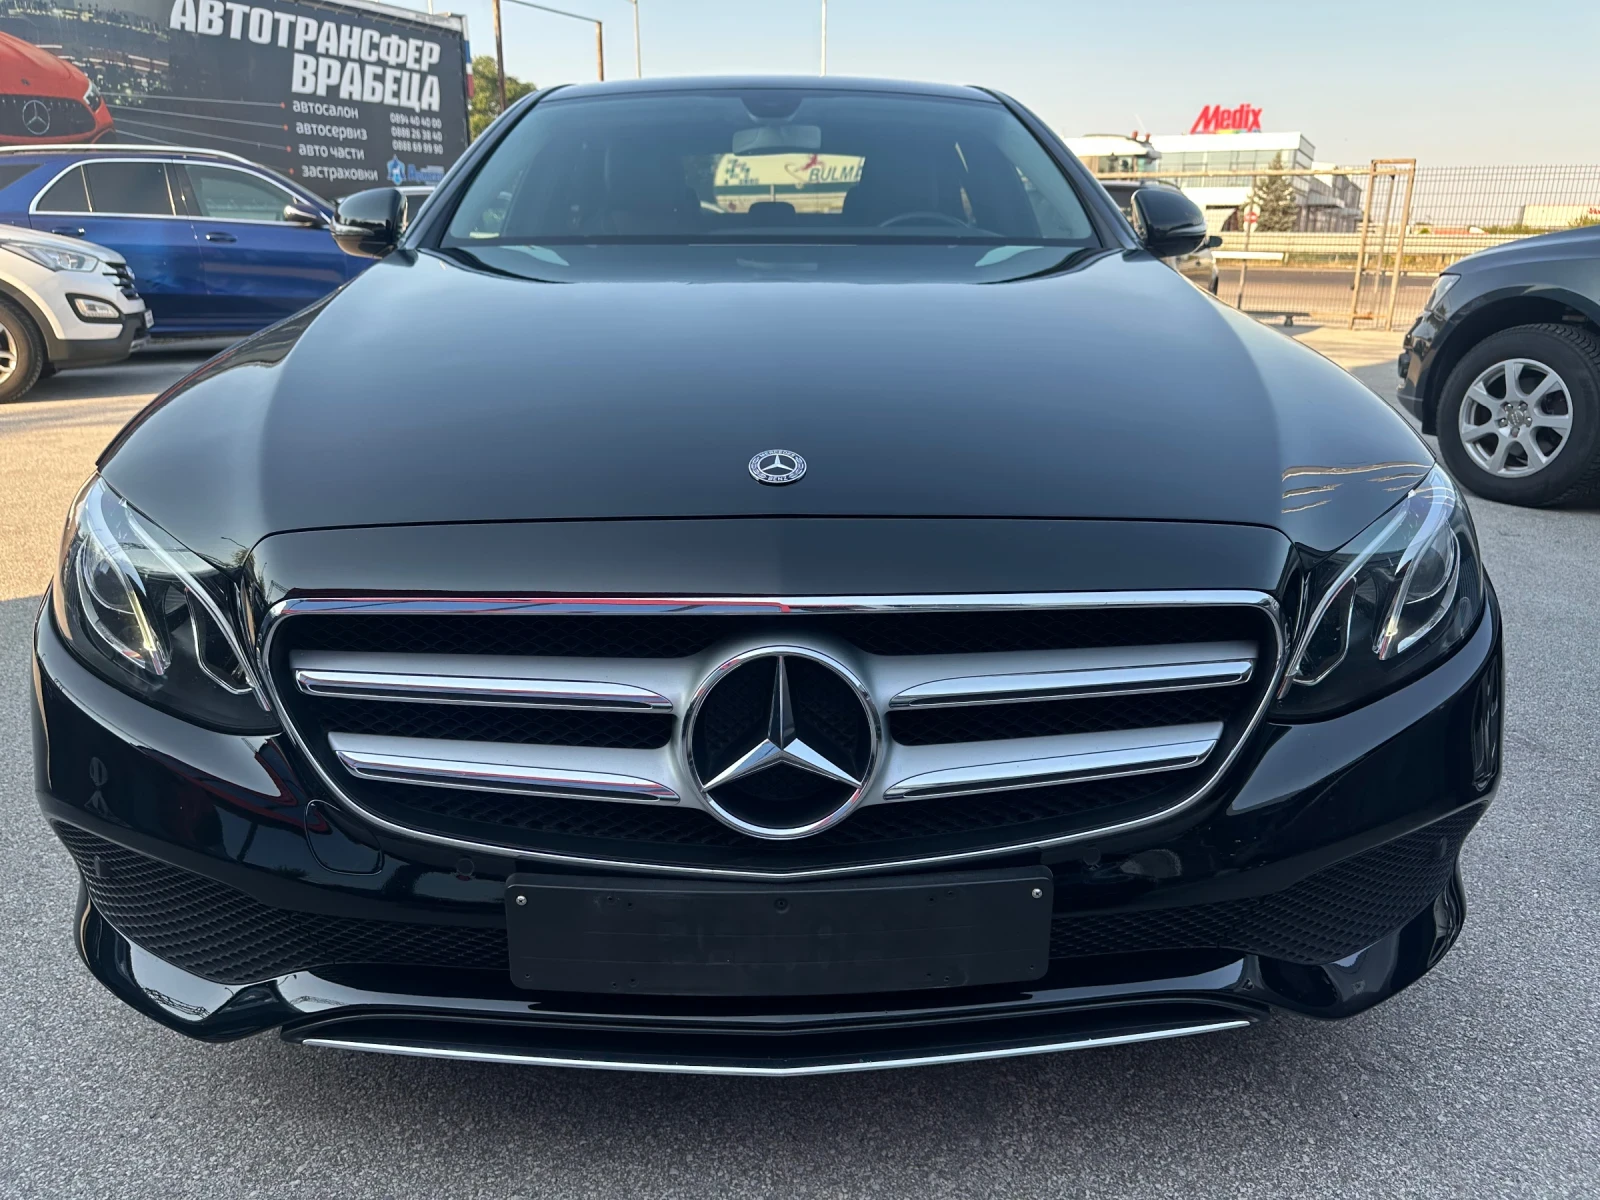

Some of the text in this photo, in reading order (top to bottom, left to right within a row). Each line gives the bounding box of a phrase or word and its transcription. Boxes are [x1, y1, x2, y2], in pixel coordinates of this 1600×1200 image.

[169, 0, 441, 72] АВТОТРАНСФЕР
[291, 52, 441, 113] ВРАБЕЦА
[292, 100, 359, 119] автосалон
[1190, 103, 1262, 134] Medix
[295, 121, 368, 141] автосервиз
[298, 143, 365, 160] авто части
[301, 165, 379, 182] застраховки
